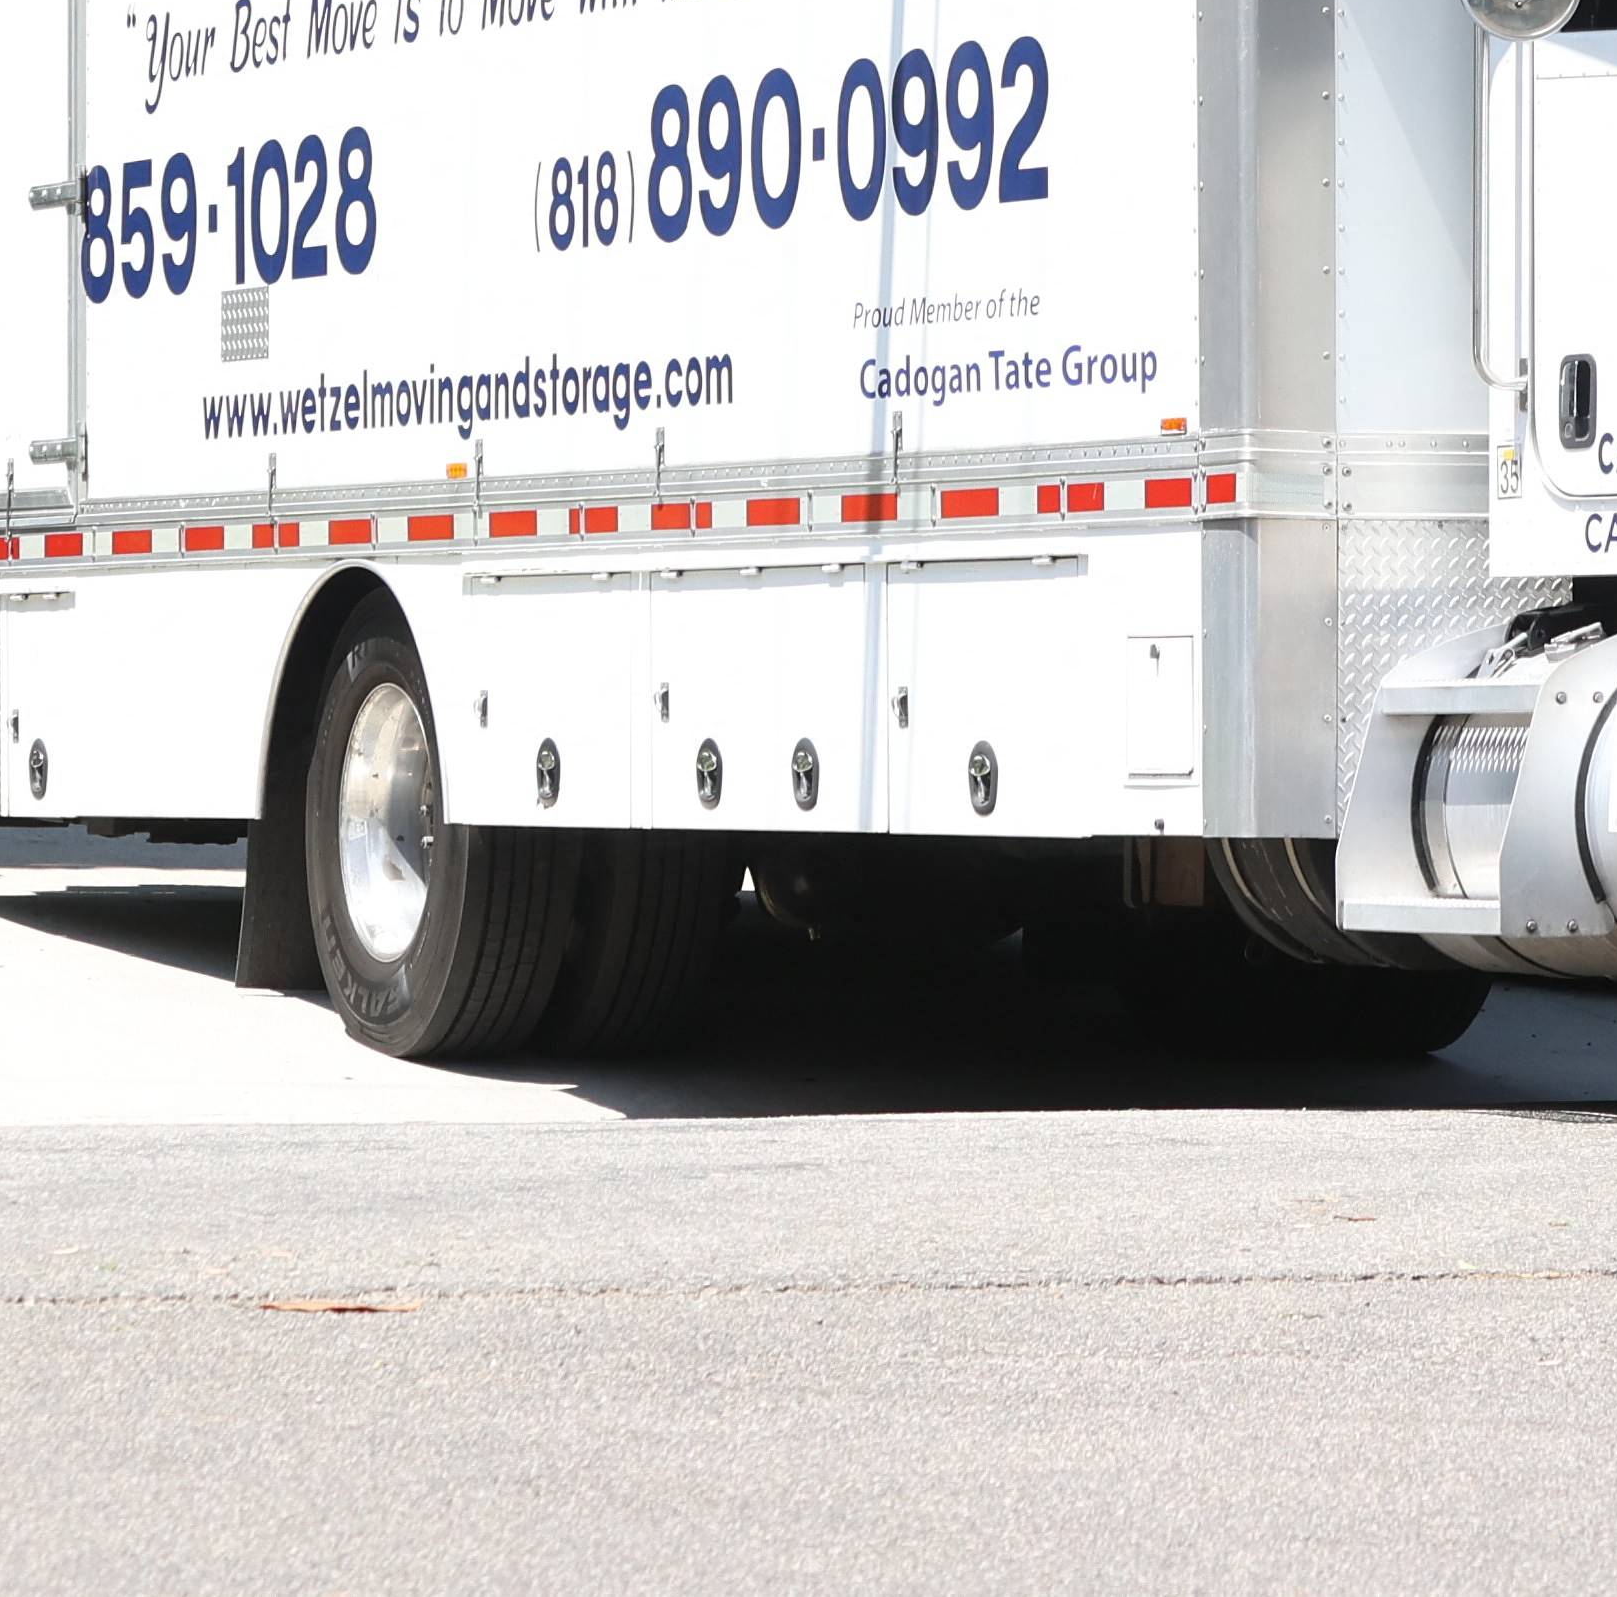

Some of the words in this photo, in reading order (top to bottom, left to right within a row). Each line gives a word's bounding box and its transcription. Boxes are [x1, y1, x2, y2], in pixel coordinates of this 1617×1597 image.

[534, 150, 636, 253] (818)
[648, 36, 1050, 244] 890-0992
[80, 126, 377, 305] 859-1028
[853, 297, 906, 329] Proud
[909, 293, 981, 326] Member
[986, 289, 1006, 319] of
[1009, 288, 1040, 318] the
[203, 353, 734, 441] www.wetzelmovingandstorage.com
[860, 354, 981, 407] Cadogan
[988, 350, 1052, 391] Tate
[1062, 345, 1158, 394] Group
[1500, 459, 1519, 494] 35
